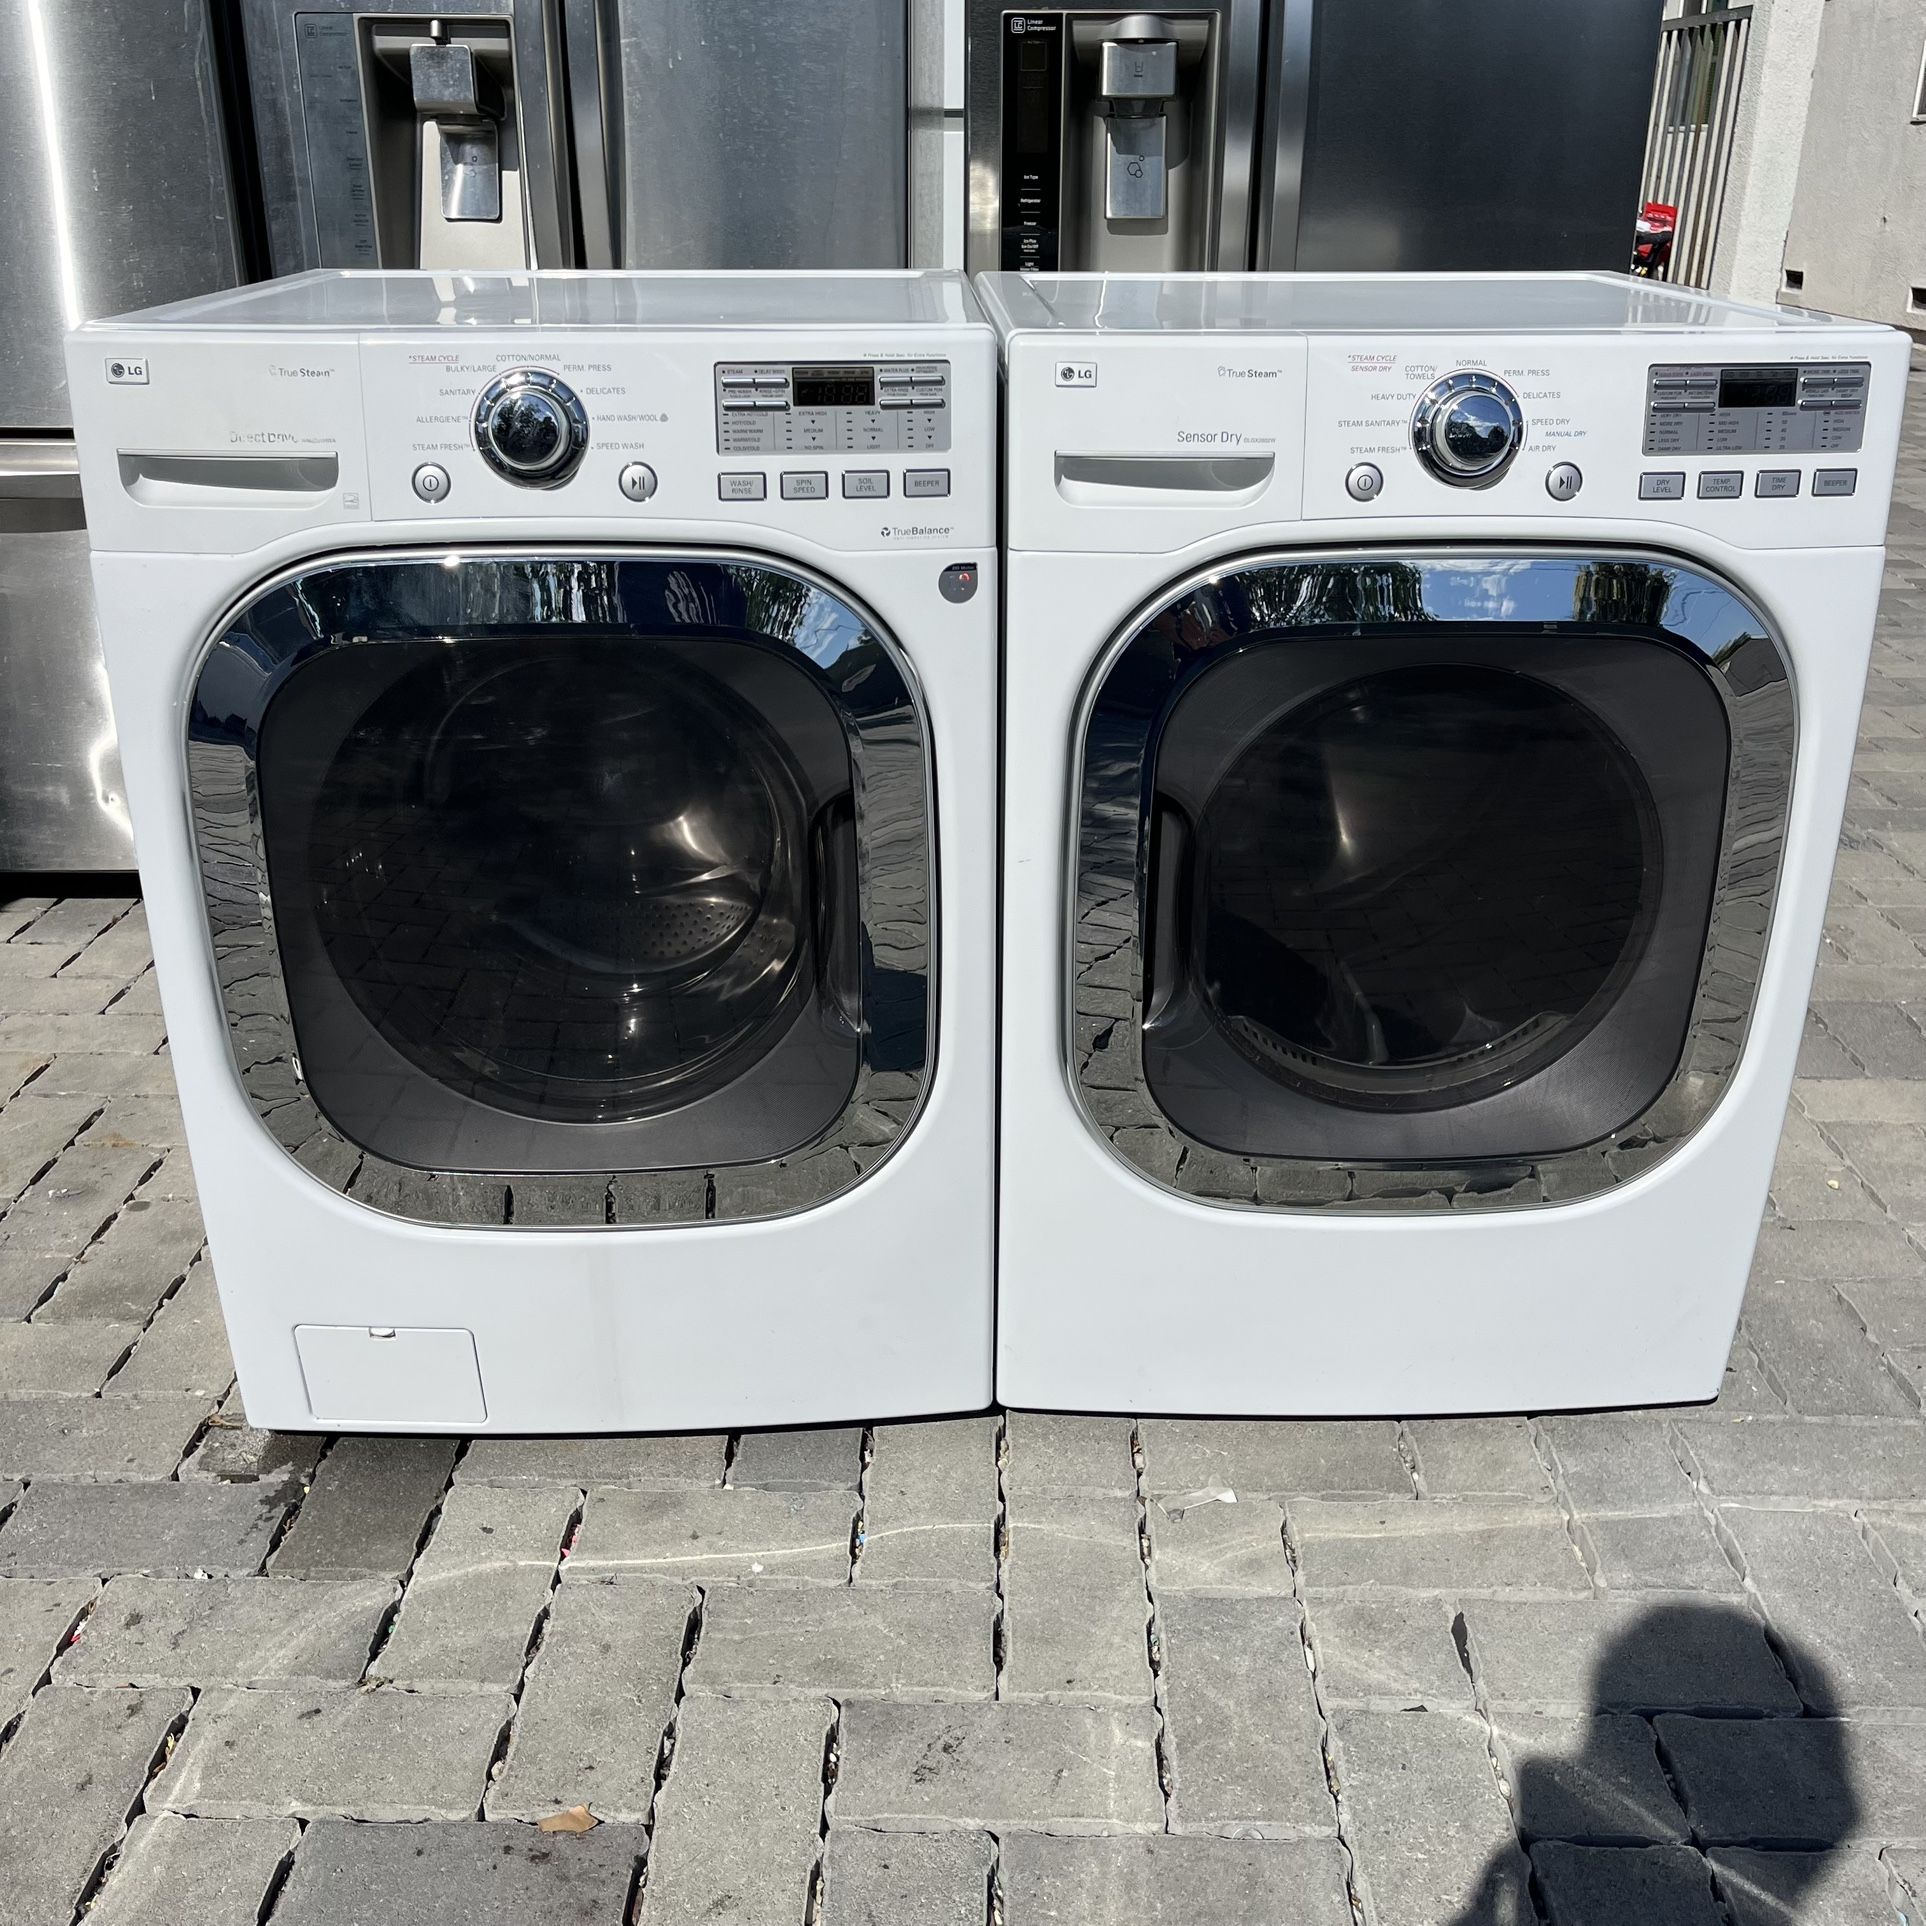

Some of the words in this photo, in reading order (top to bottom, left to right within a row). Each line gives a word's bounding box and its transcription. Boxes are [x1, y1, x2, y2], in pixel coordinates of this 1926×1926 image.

[128, 366, 143, 376] LG
[1078, 370, 1092, 379] LG
[1177, 431, 1218, 443] Sensor
[1221, 431, 1242, 446] Dry
